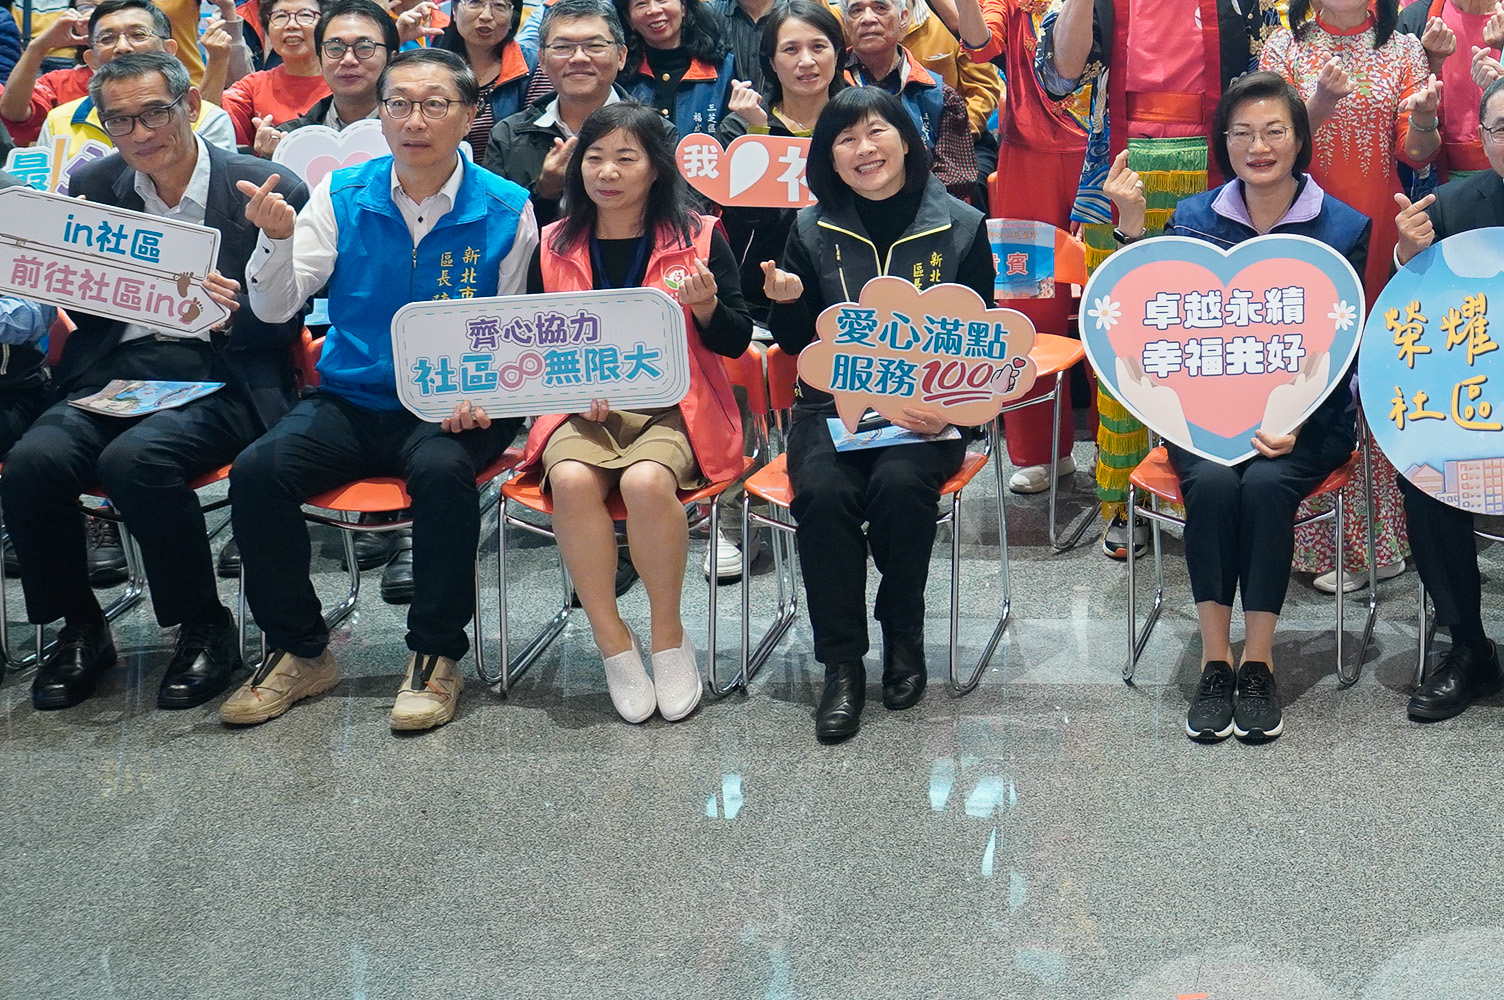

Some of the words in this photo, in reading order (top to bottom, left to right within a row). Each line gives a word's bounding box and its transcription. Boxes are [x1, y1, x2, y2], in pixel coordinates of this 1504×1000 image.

[682, 144, 720, 180] 我
[64, 213, 164, 264] in社區
[10, 254, 200, 325] 前往社區ing
[458, 246, 481, 299] 新北市
[467, 311, 601, 350] 齊心協力
[1143, 286, 1306, 330] 卓越永續
[836, 308, 1009, 361] 愛心滿點
[1142, 333, 1306, 379] 幸福共好
